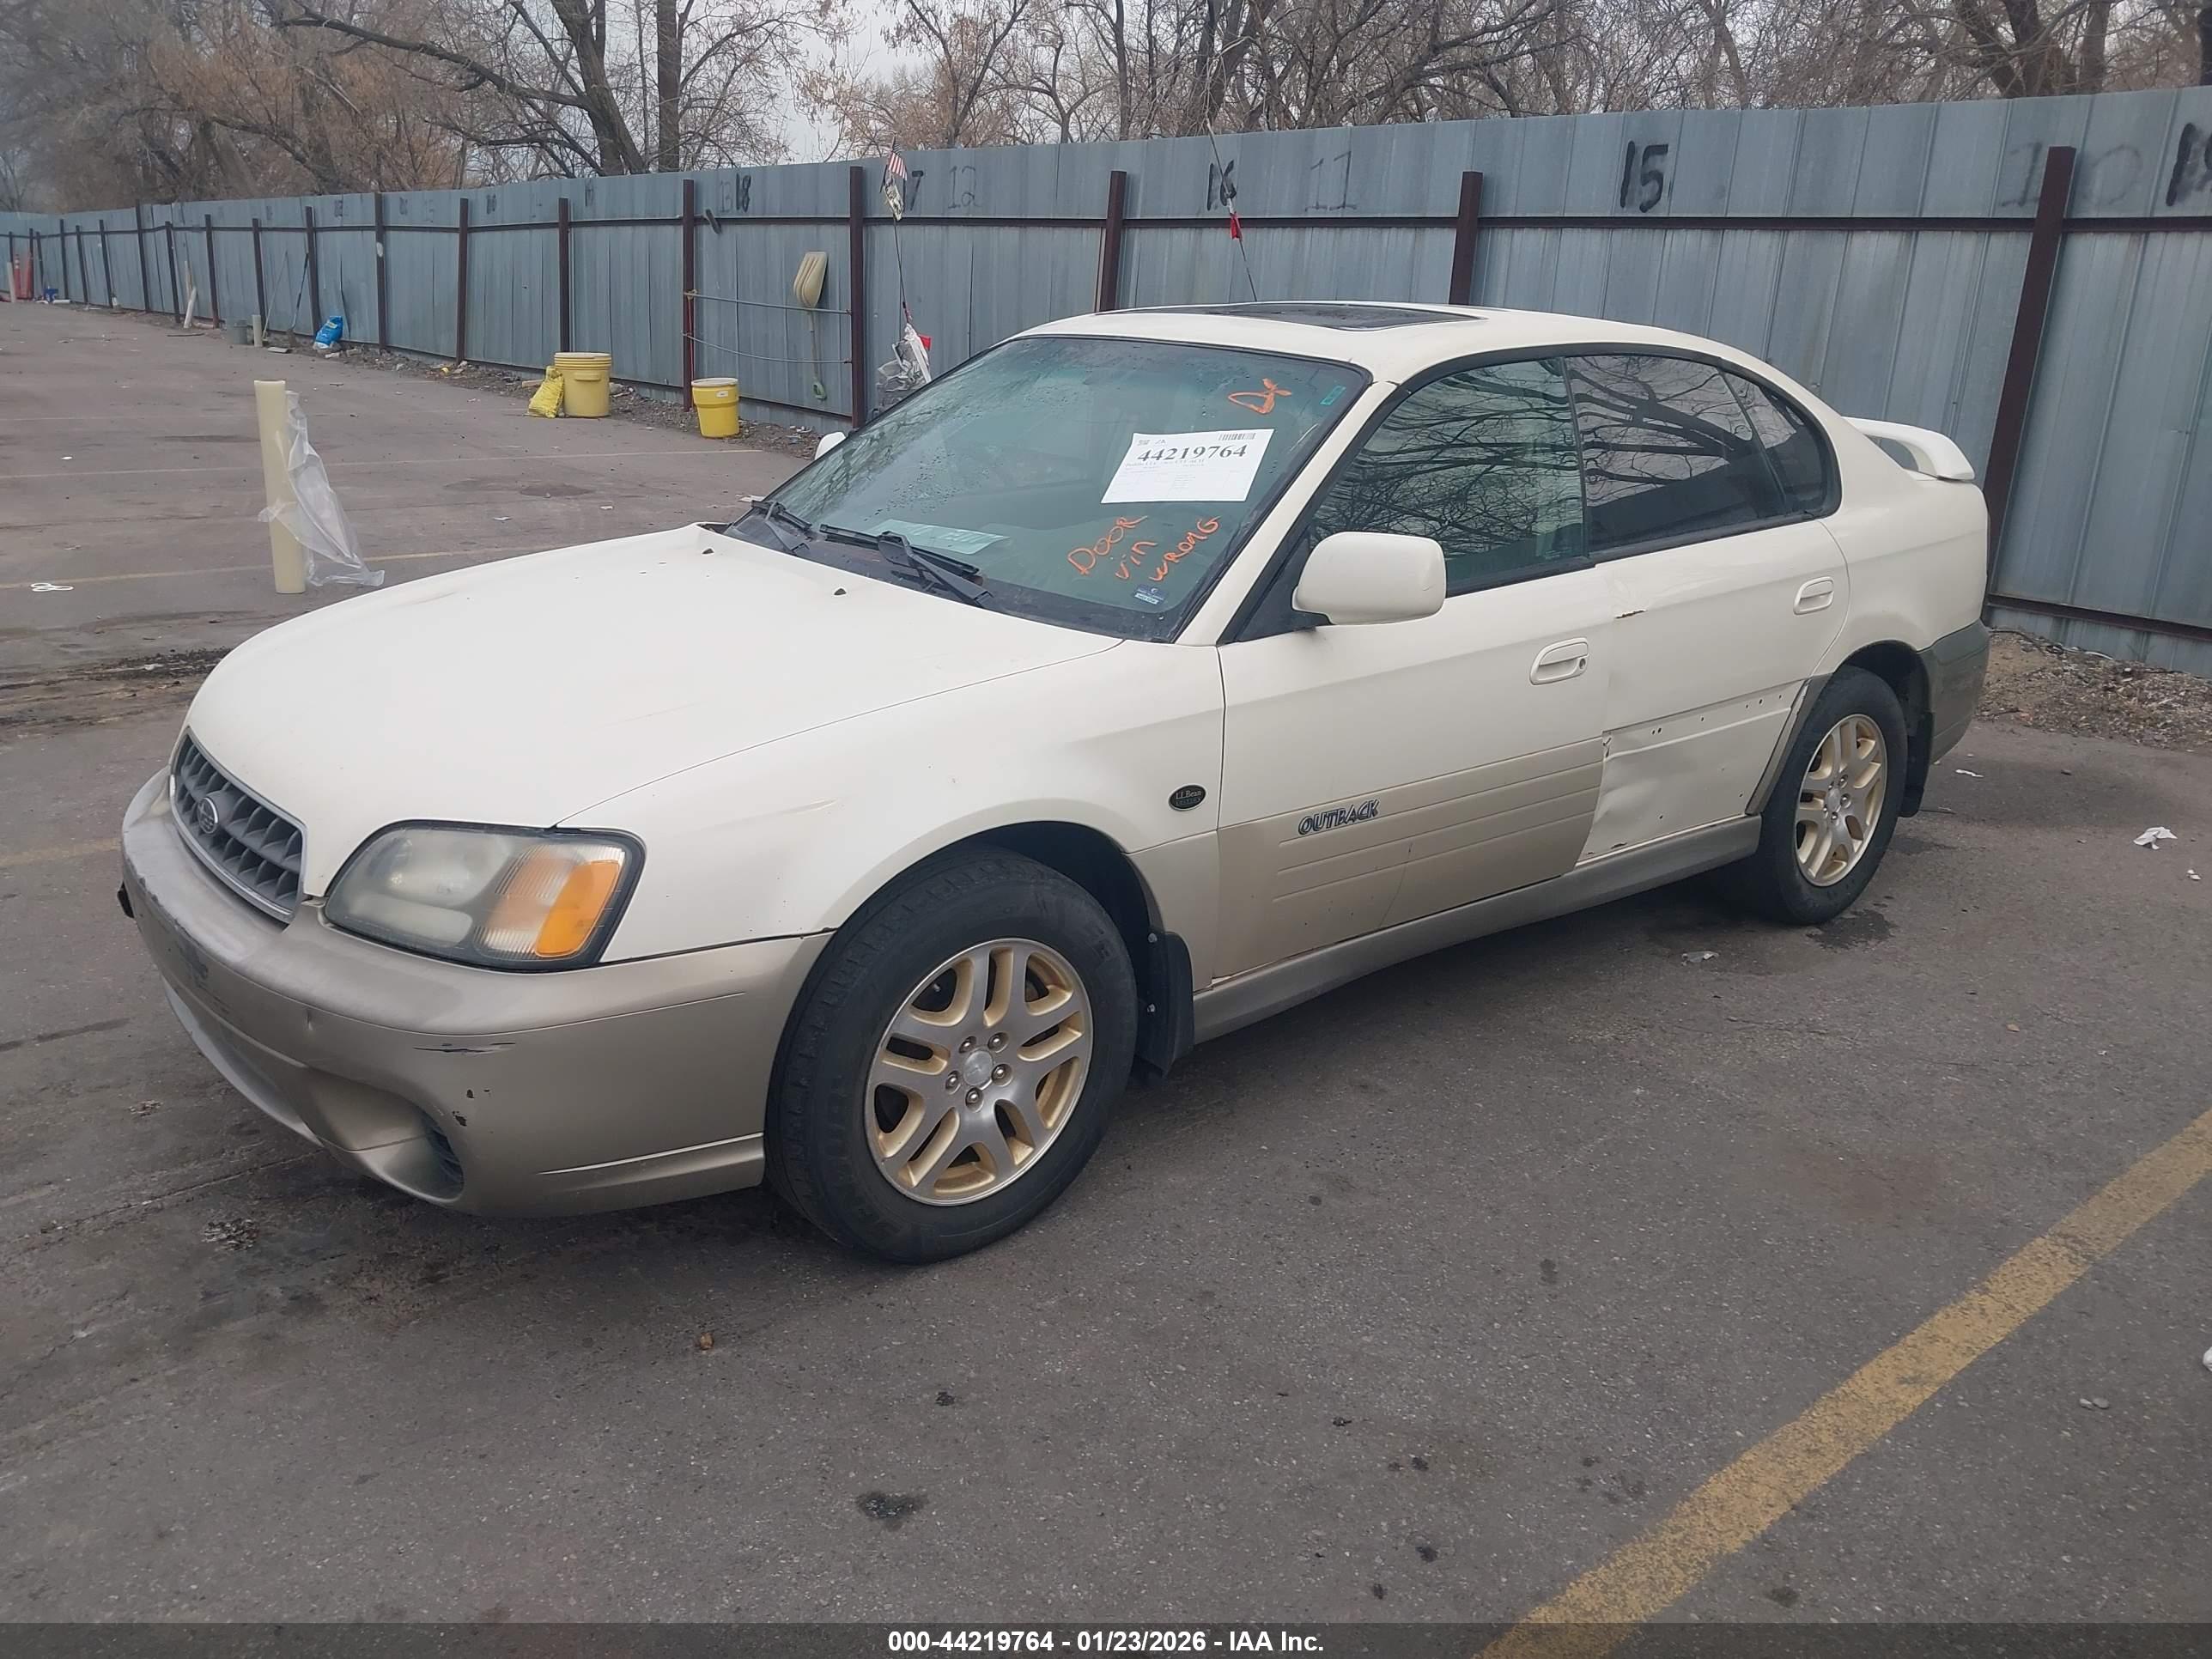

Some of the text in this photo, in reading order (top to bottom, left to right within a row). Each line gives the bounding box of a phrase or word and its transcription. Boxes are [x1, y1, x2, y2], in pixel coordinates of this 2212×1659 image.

[735, 172, 752, 213] 18
[947, 165, 982, 210] 12
[1304, 150, 1358, 212] 11
[1620, 140, 1669, 213] 15
[1137, 444, 1248, 462] 44219764
[1297, 799, 1379, 836] OUTBACK
